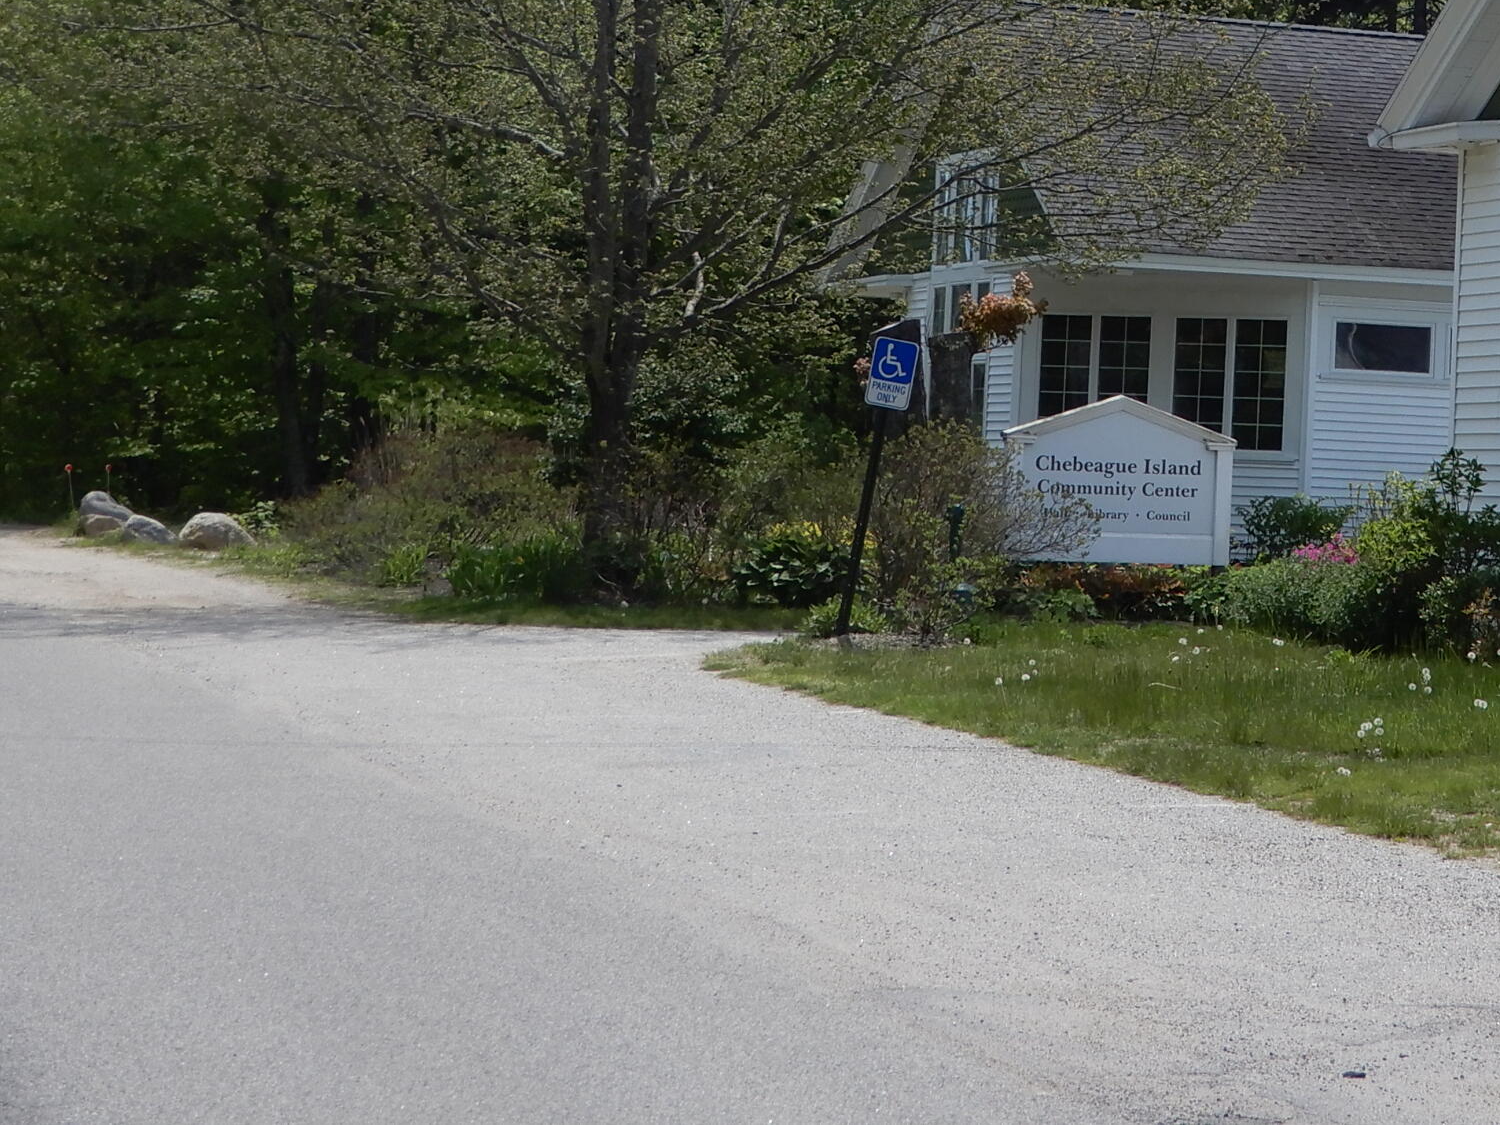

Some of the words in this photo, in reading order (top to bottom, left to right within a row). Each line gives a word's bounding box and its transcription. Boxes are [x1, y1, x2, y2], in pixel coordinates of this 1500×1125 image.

[872, 381, 906, 395] PARKING
[876, 392, 897, 403] ONLY
[1036, 454, 1137, 478] Chebeague
[1144, 459, 1202, 476] Island
[1037, 479, 1136, 500] Community
[1142, 482, 1198, 498] Center
[1146, 510, 1191, 522] Council
